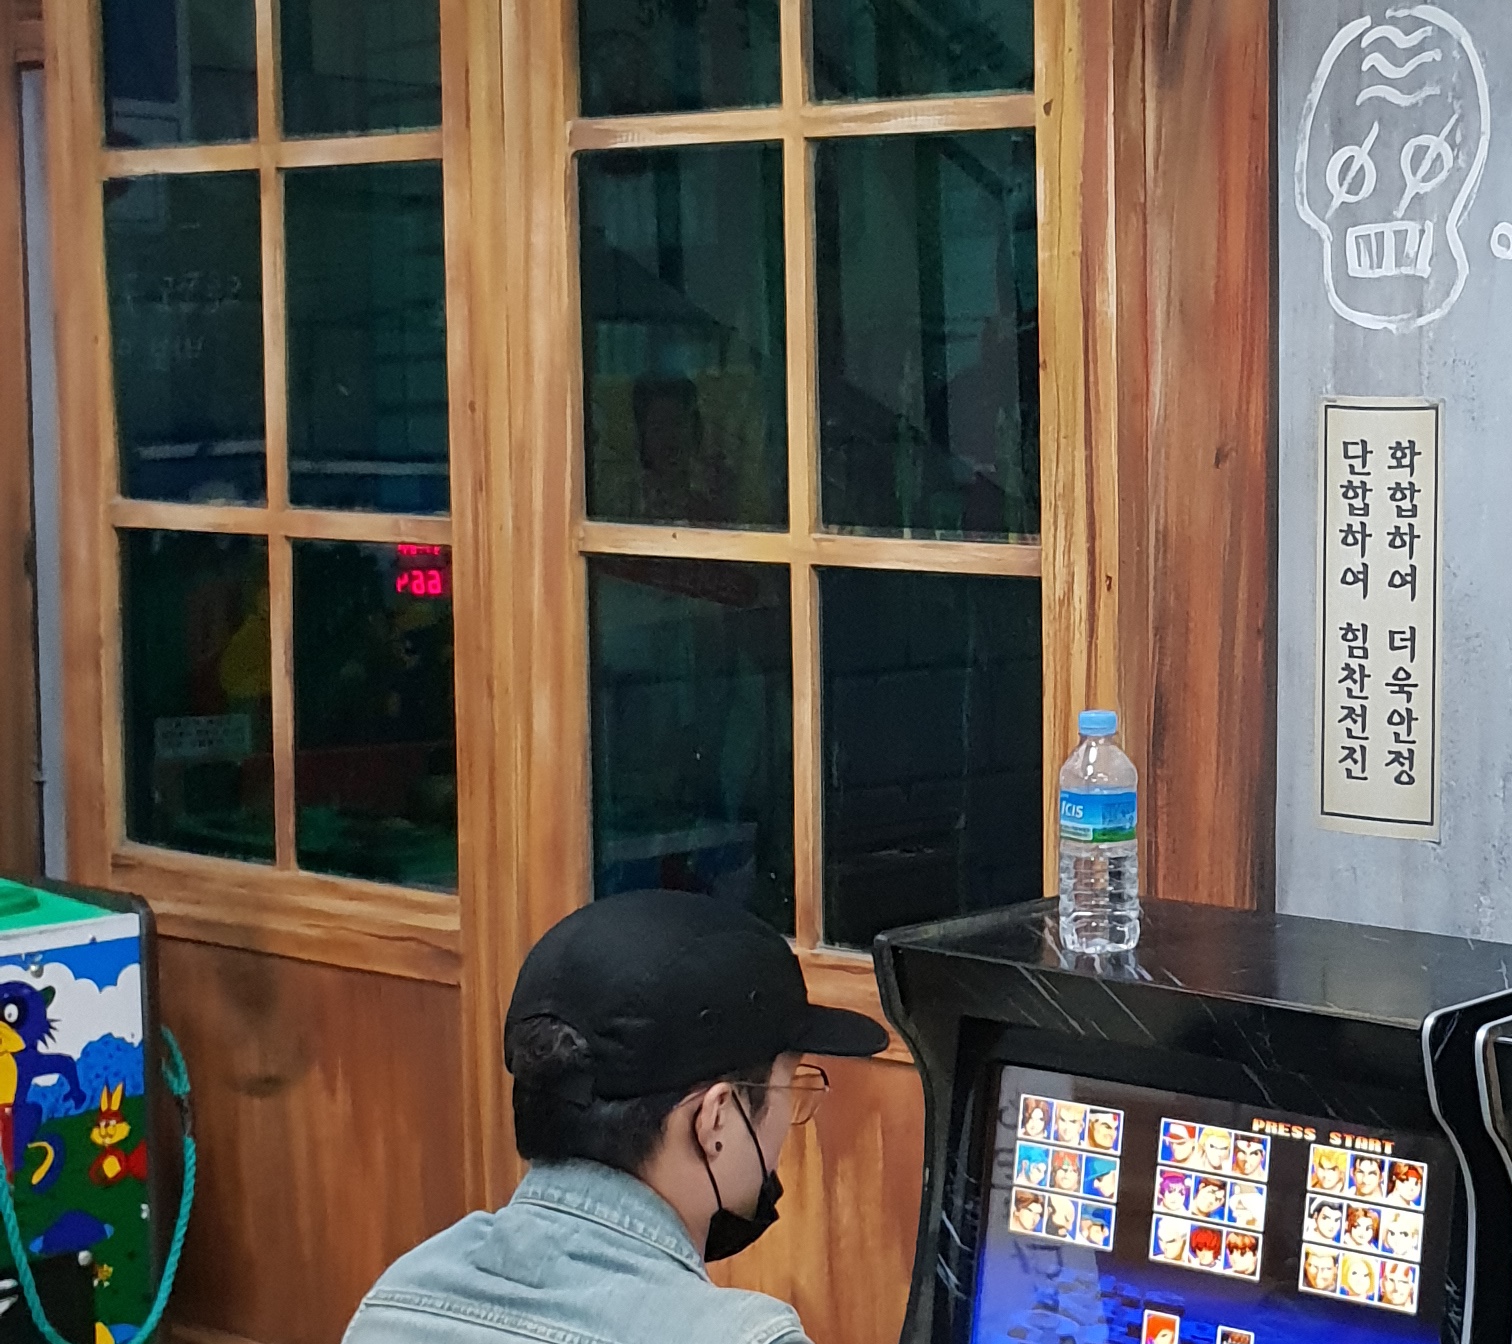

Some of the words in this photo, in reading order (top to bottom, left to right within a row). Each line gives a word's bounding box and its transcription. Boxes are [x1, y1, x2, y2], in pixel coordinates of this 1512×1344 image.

[1339, 438, 1374, 601] 단합하여
[1386, 438, 1423, 602] 화합하여
[1251, 1117, 1317, 1142] PRESS
[1328, 1131, 1396, 1156] START
